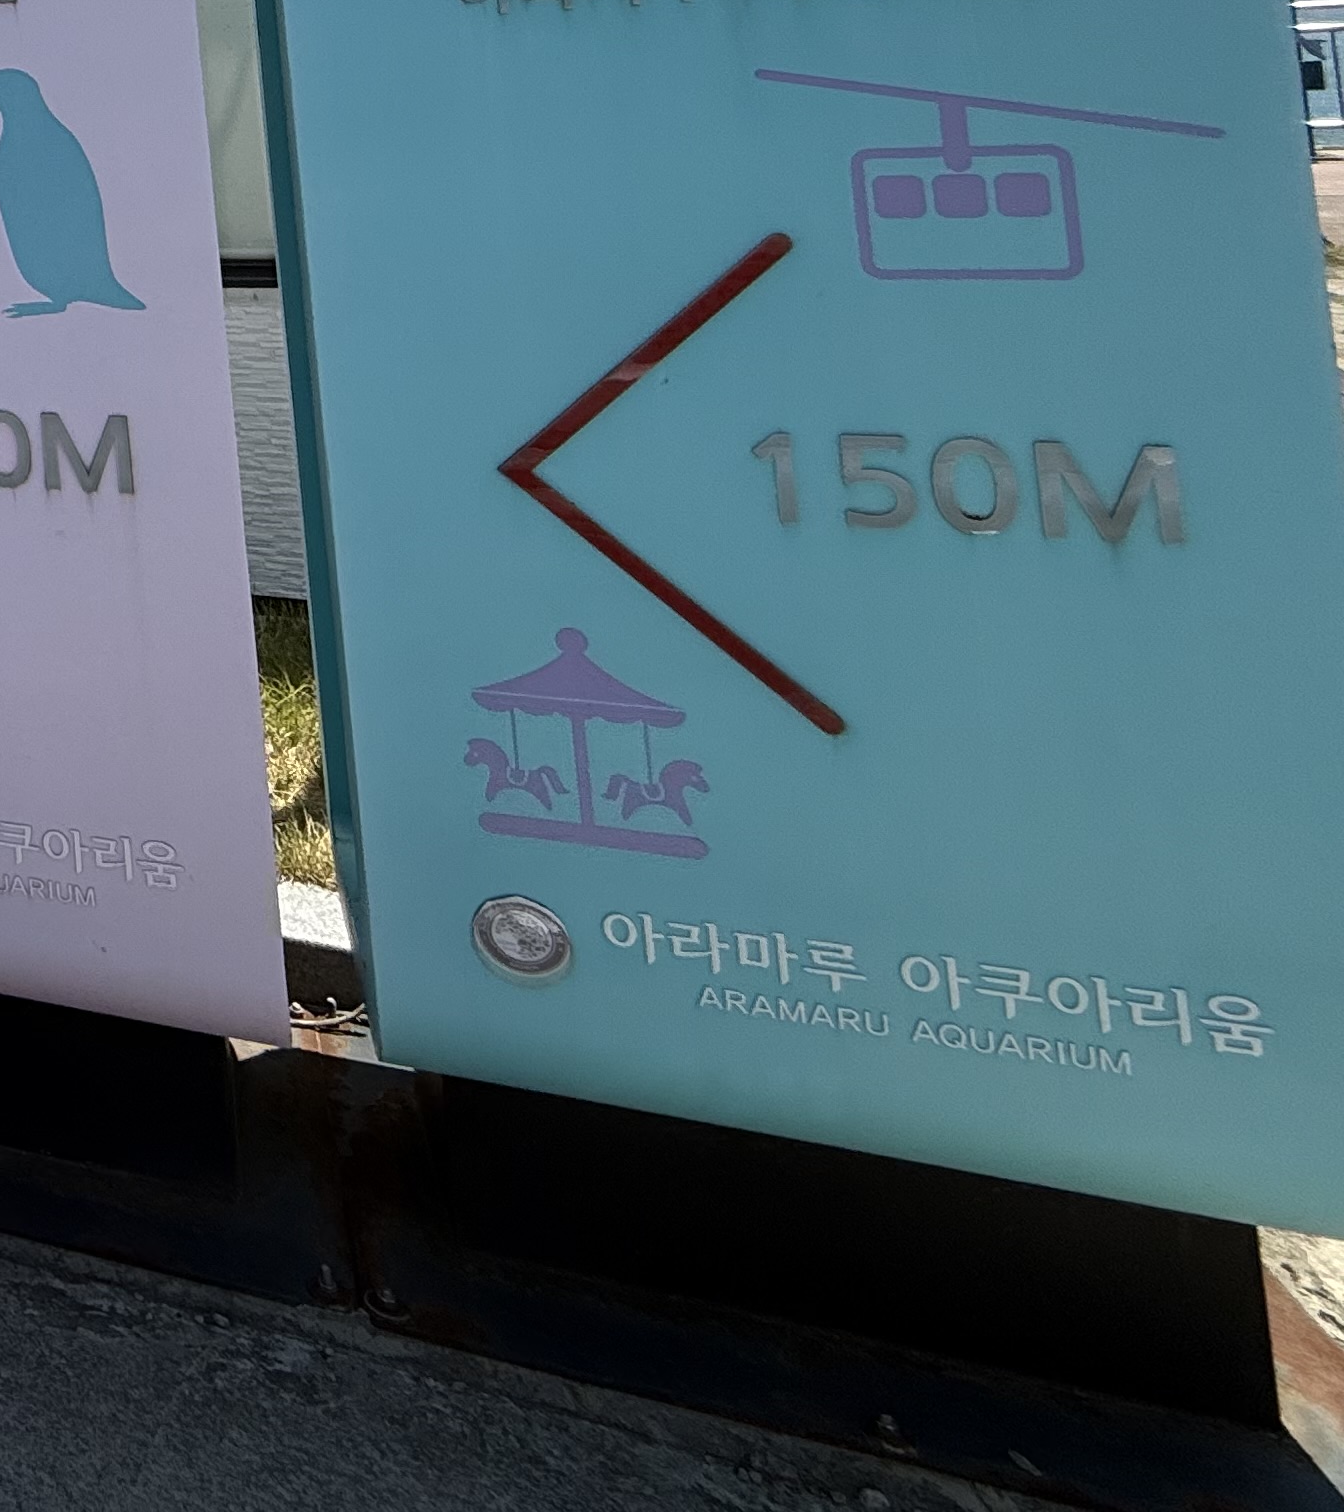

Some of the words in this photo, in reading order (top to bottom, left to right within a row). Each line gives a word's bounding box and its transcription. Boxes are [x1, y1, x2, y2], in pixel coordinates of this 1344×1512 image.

[752, 431, 1185, 545] 150M
[603, 912, 866, 992] 아라마루
[900, 954, 1275, 1057] 아쿠아리움
[699, 985, 890, 1038] ARAMARU
[911, 1018, 1133, 1076] AQUARIUM
